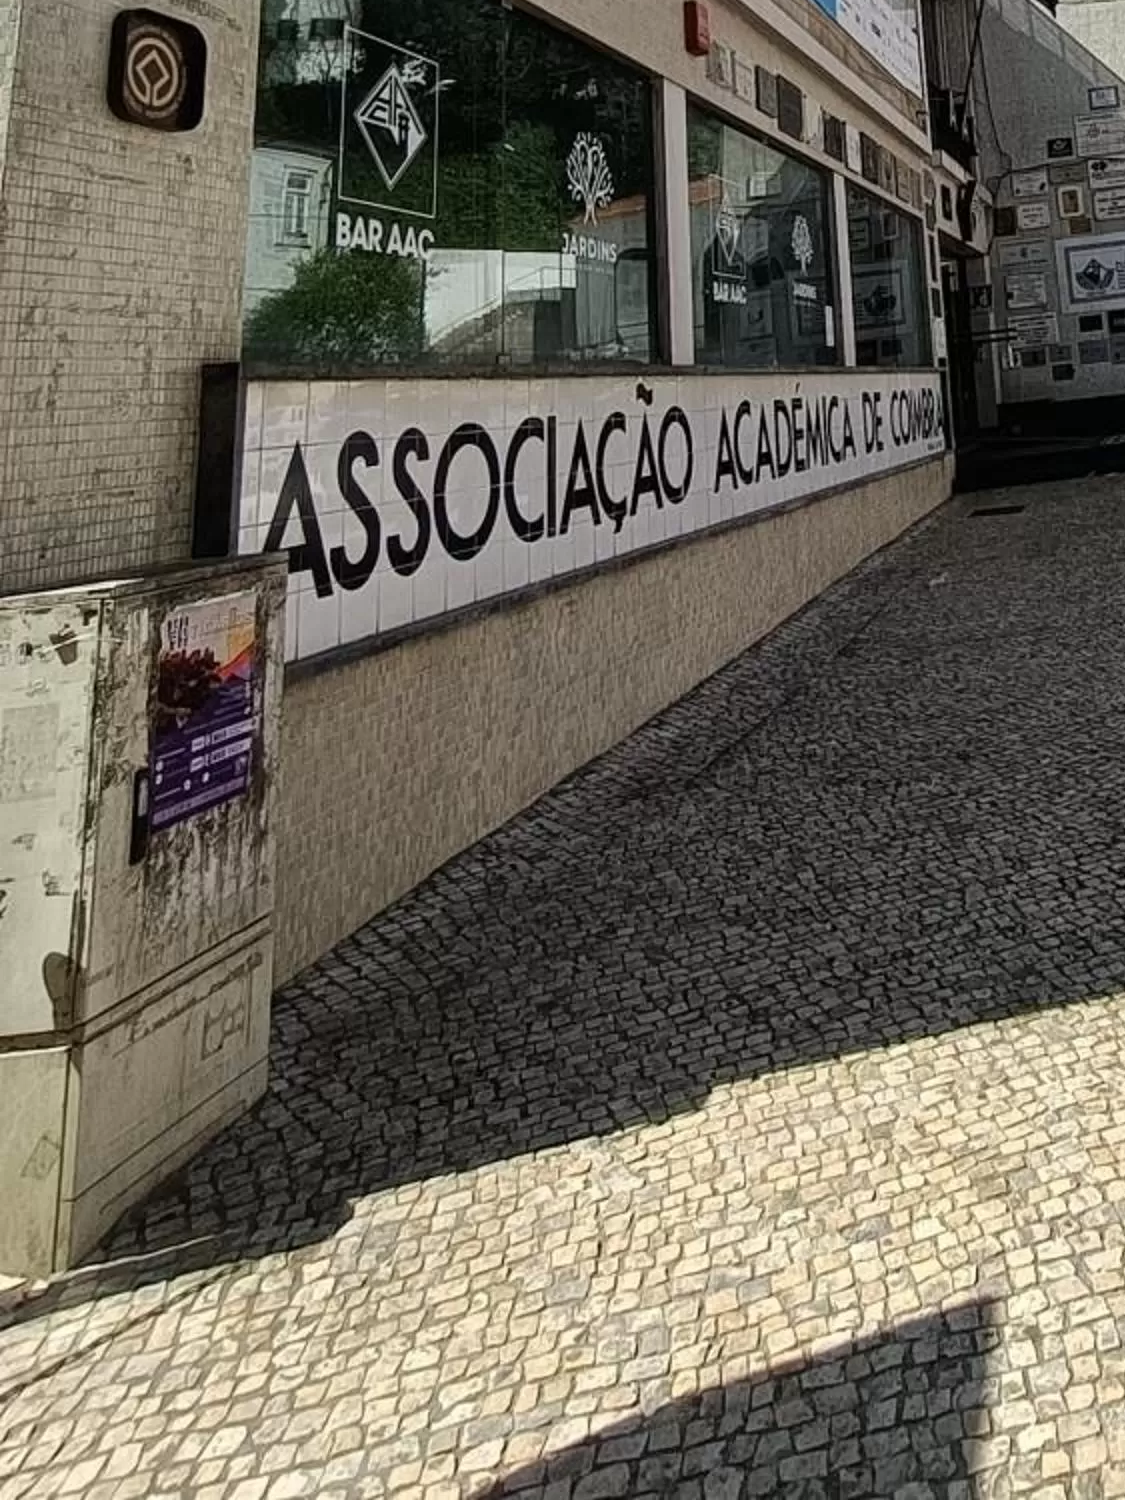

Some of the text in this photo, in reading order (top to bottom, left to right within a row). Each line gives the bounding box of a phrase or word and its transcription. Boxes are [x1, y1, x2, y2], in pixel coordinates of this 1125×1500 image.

[335, 211, 435, 260] BAR AAC
[562, 232, 617, 263] JARDINS
[262, 382, 694, 598] ASSOCIAÇÃO
[713, 383, 857, 494] ACADÉMICA
[861, 391, 885, 455] DE
